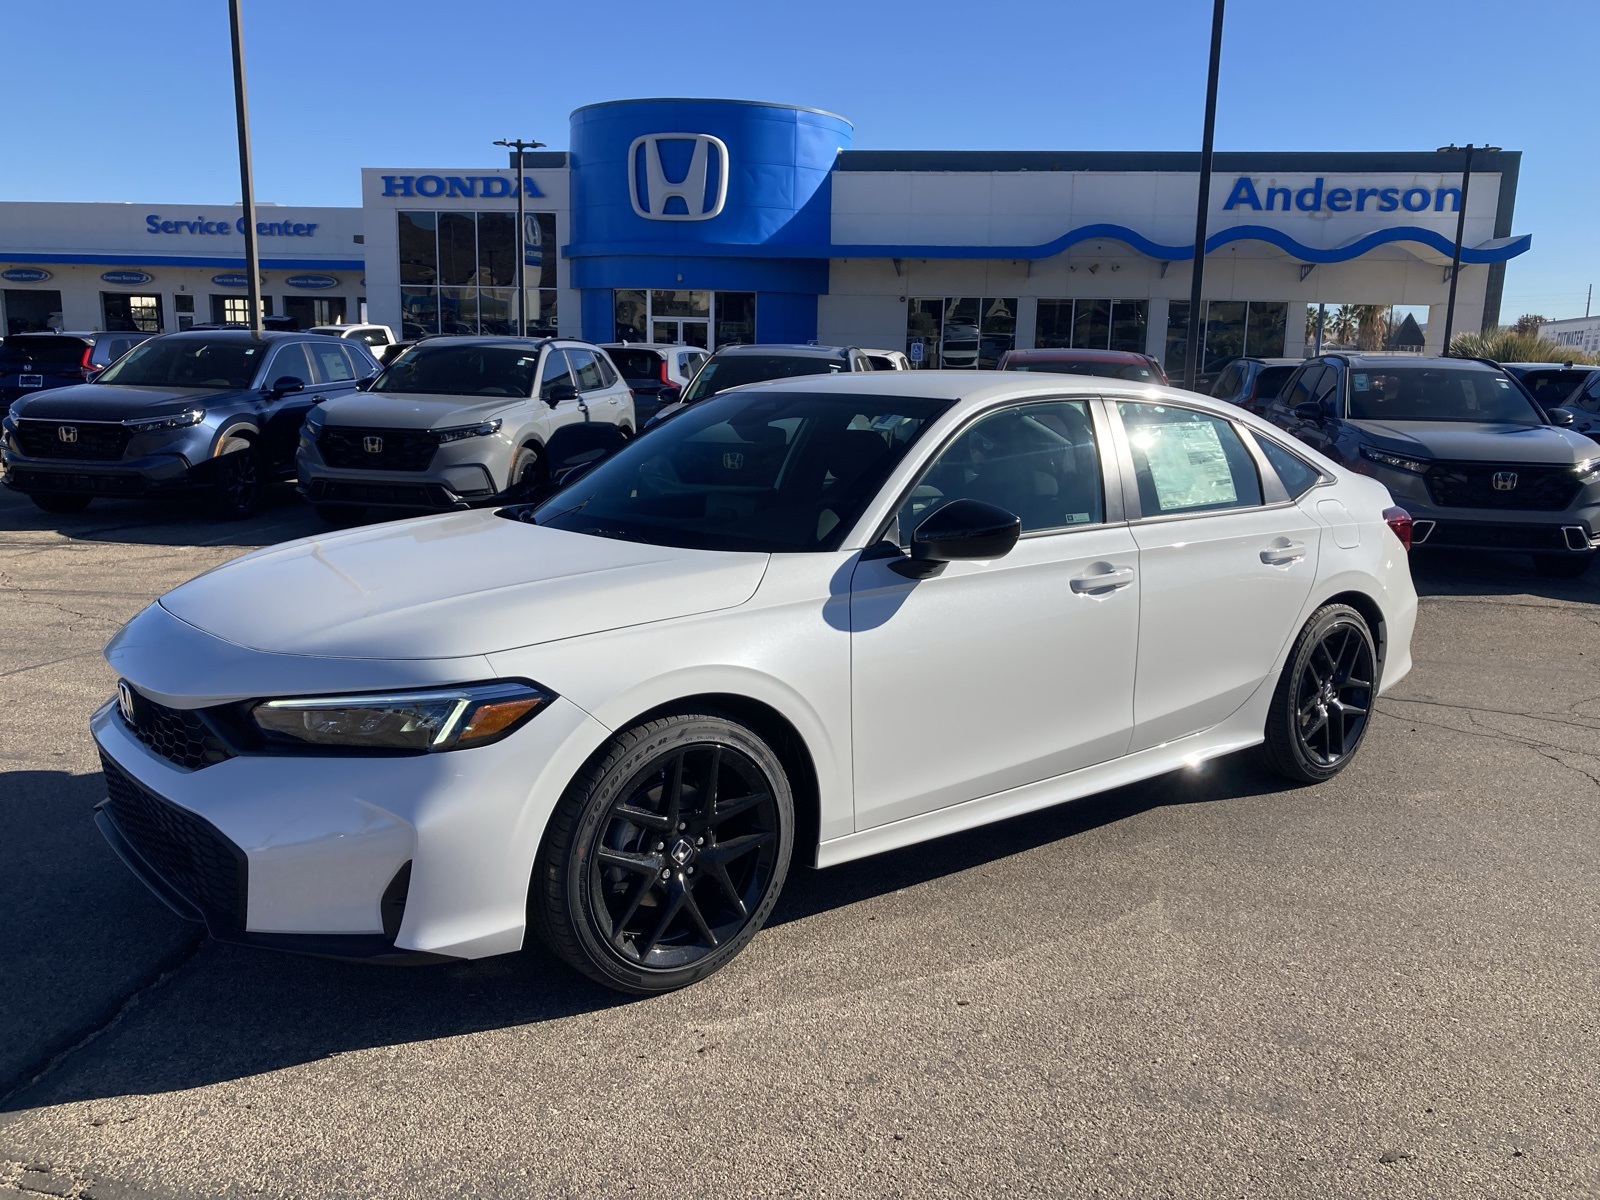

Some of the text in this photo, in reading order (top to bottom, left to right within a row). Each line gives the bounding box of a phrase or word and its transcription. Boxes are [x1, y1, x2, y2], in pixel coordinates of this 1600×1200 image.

[381, 175, 546, 198] HONDA
[1222, 177, 1462, 212] Anderson
[146, 214, 231, 235] Service
[587, 737, 668, 826] GOODYEAR
